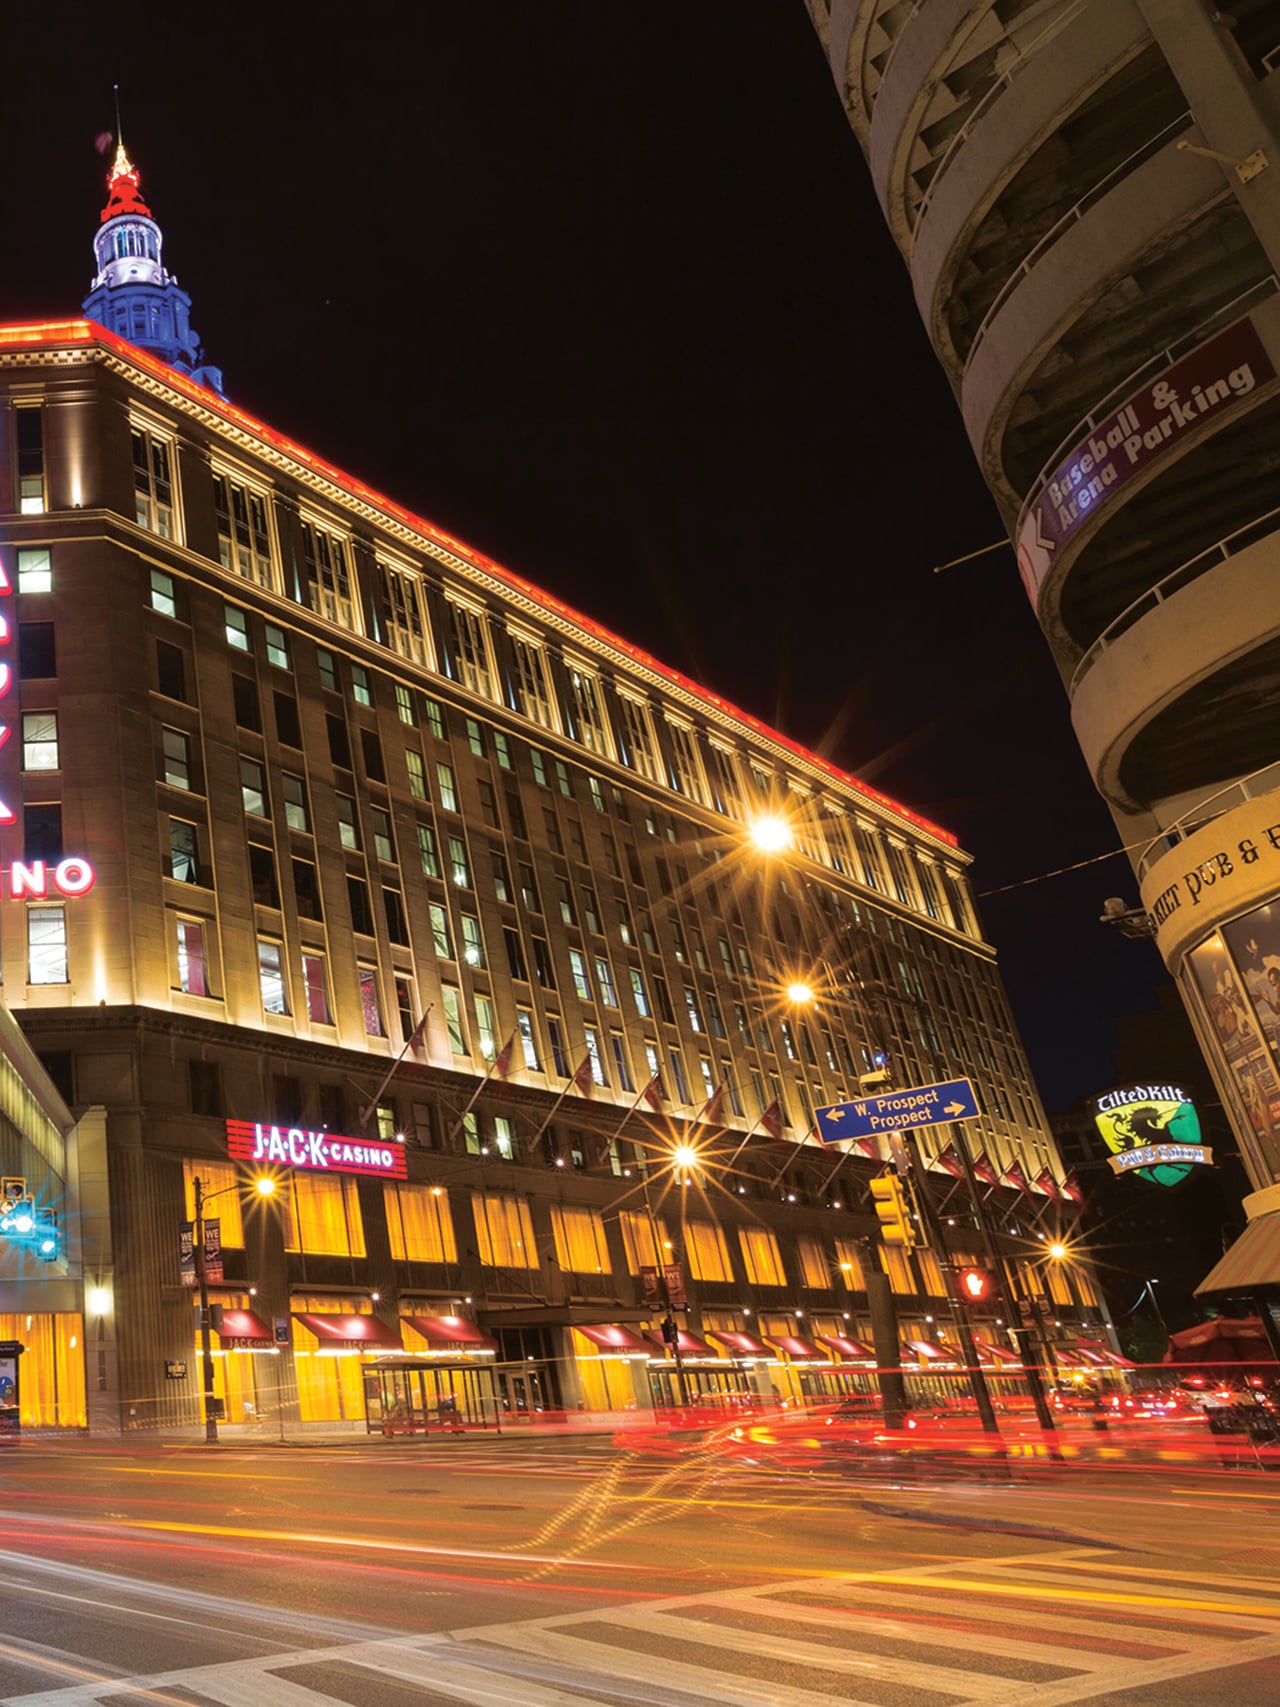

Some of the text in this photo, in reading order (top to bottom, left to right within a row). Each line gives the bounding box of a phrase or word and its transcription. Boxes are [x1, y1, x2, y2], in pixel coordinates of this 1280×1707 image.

[1048, 381, 1179, 509] Baseball &
[1057, 362, 1256, 532] Arena Parking
[1153, 883, 1182, 927] KILT
[1182, 852, 1234, 906] PUB
[1238, 839, 1260, 864] &
[854, 1089, 939, 1117] W. Prospect
[870, 1107, 933, 1129] Prospect
[253, 1123, 393, 1167] JACK CASINO
[1116, 1148, 1143, 1168] Pub
[1143, 1147, 1156, 1161] &
[205, 1228, 219, 1239] WE
[229, 1338, 253, 1348] JACK
